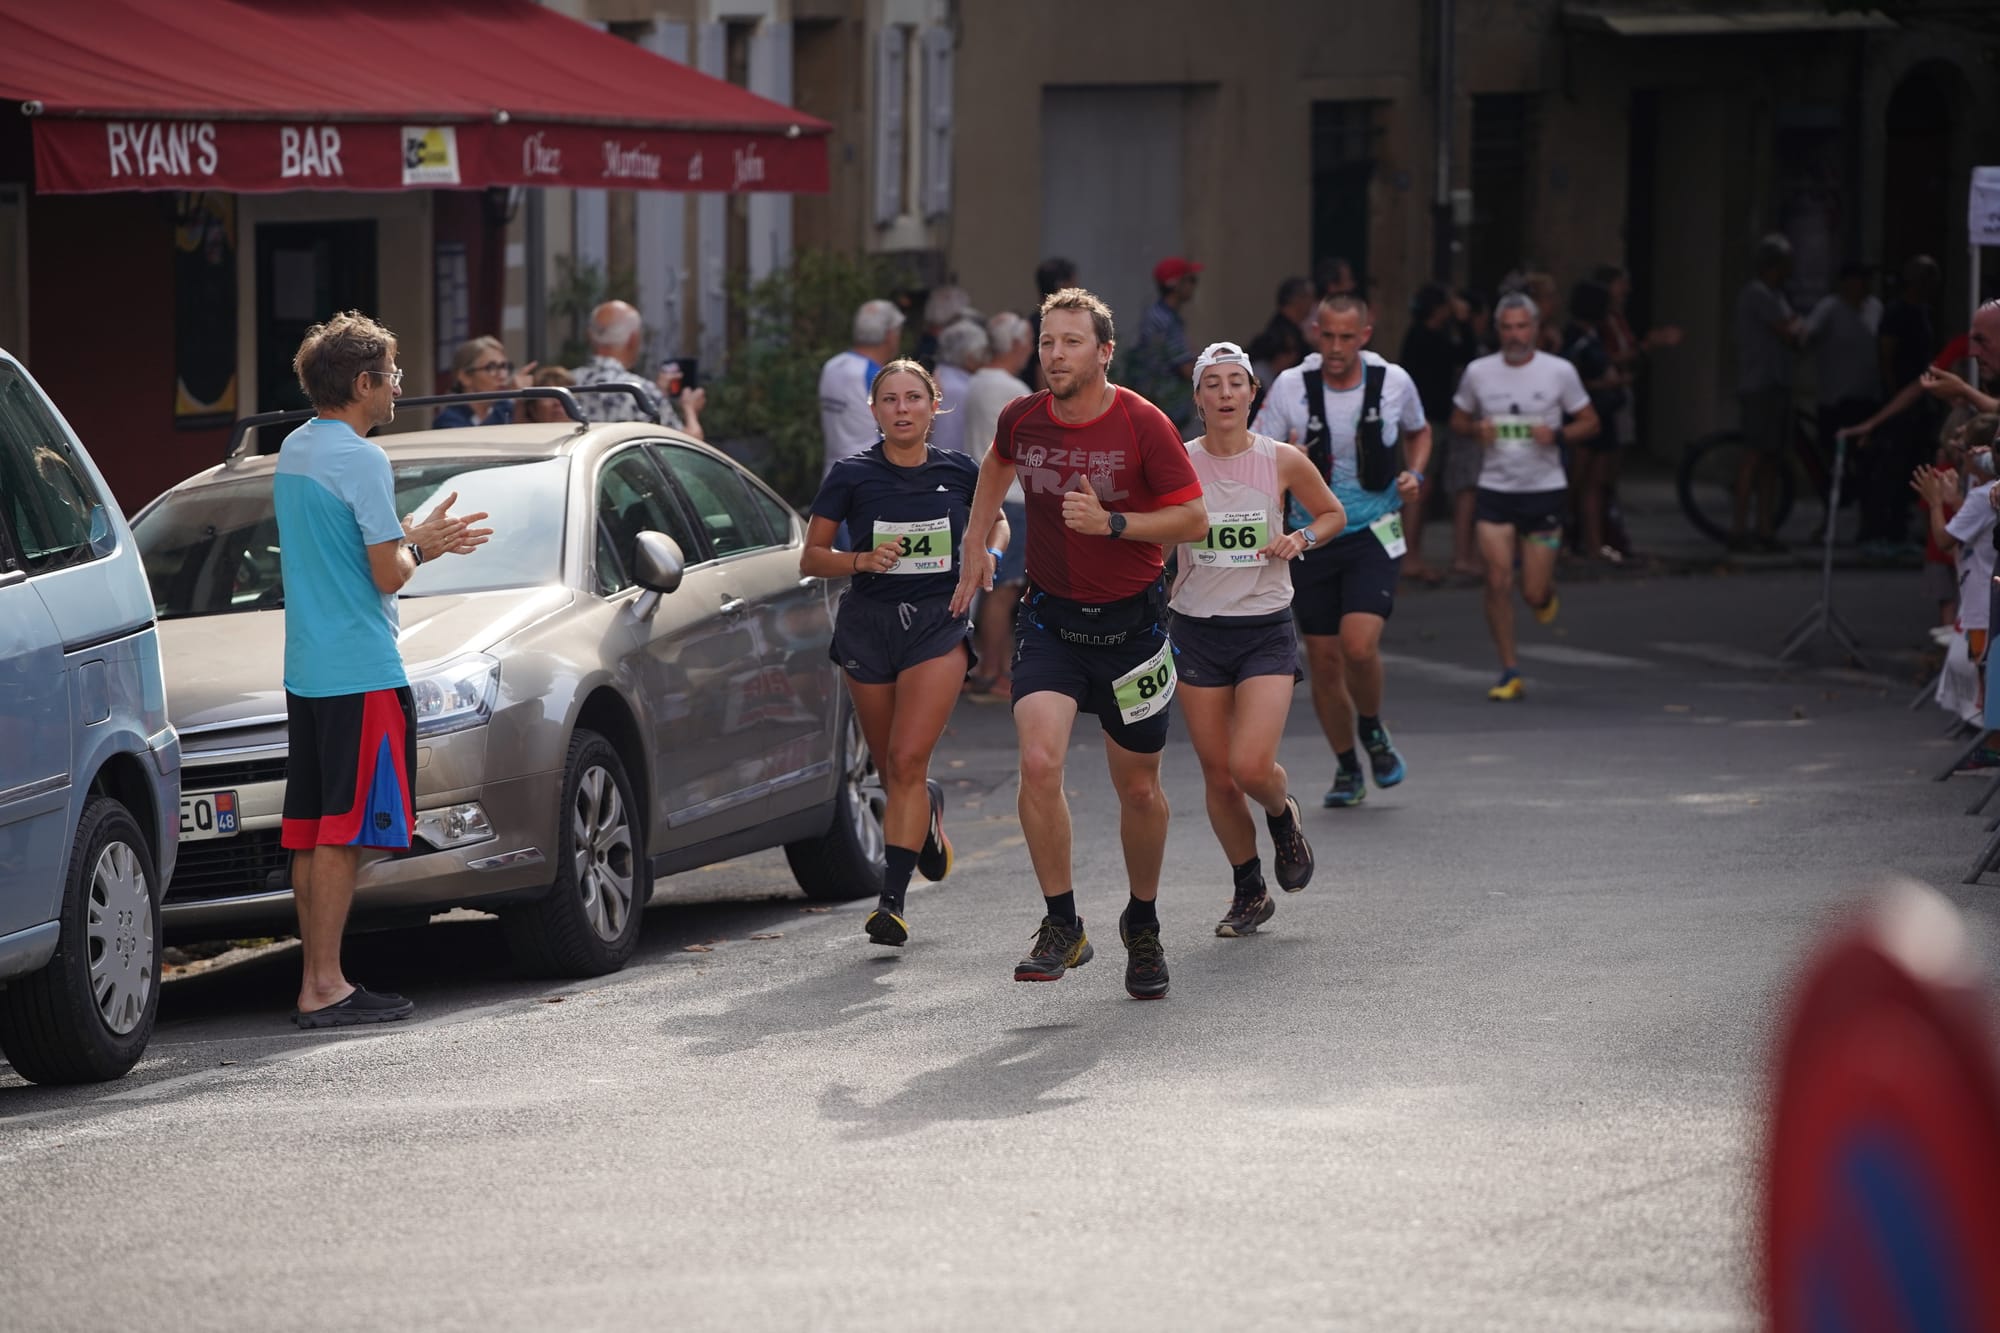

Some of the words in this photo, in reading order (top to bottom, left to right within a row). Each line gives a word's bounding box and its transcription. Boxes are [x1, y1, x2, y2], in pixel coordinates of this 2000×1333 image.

[106, 122, 218, 177] RYAN'S
[280, 126, 344, 177] BAR
[523, 131, 561, 176] Chez
[602, 140, 661, 179] Martine
[688, 150, 703, 181] et
[1016, 443, 1127, 471] LOZÈRE
[1206, 526, 1257, 549] 166
[1137, 664, 1169, 699] 80
[219, 814, 235, 830] 48
